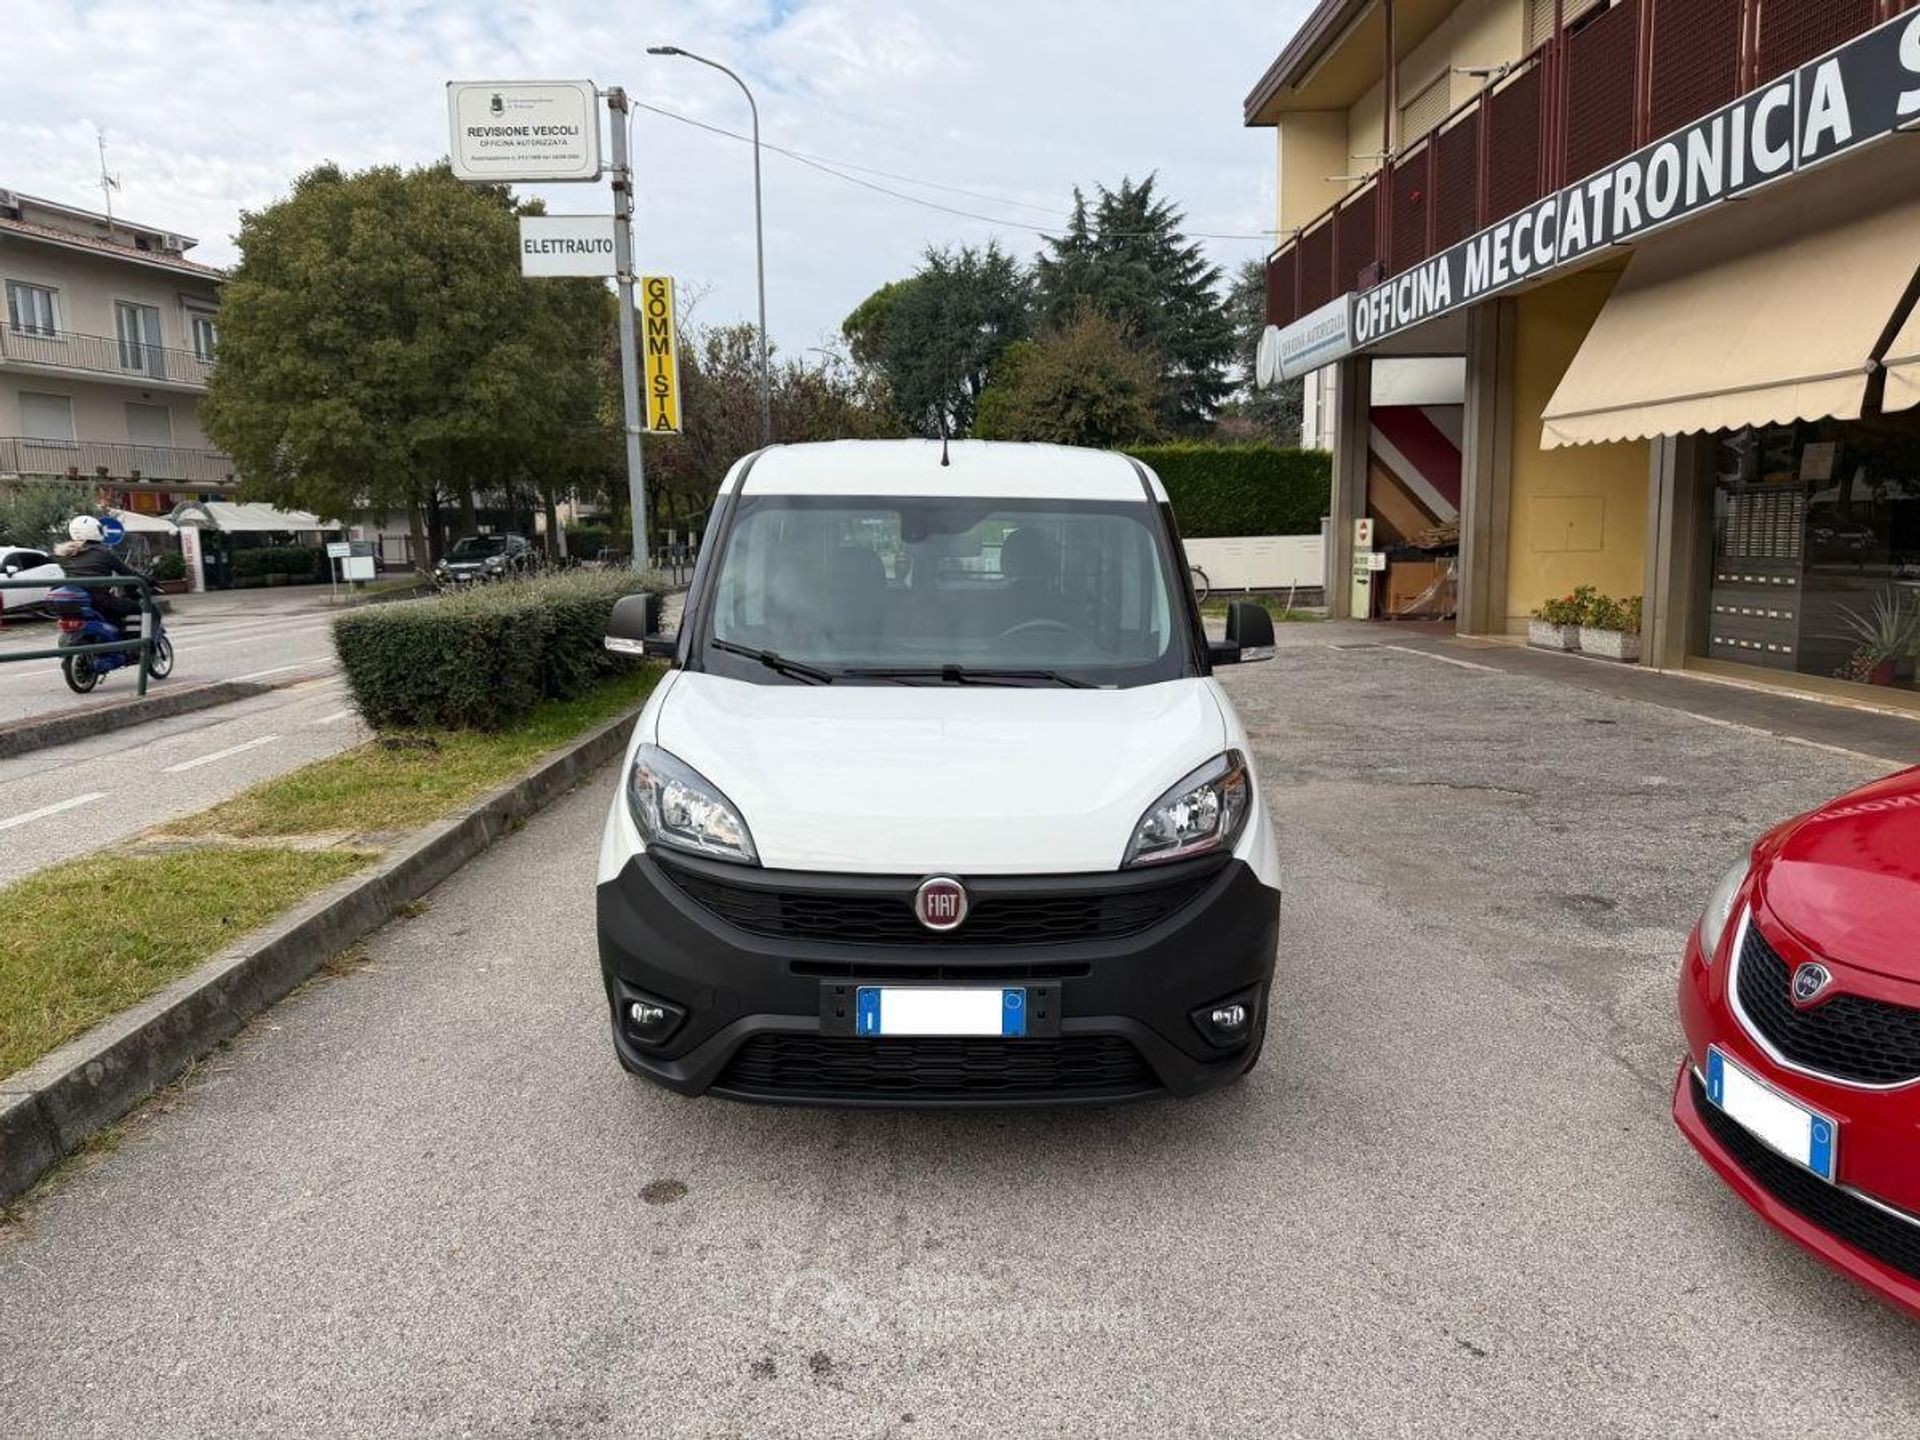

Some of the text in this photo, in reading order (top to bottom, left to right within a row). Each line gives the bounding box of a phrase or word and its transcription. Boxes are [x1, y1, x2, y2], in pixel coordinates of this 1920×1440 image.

[467, 125, 579, 137] REVISIONE VEICOLI
[480, 138, 568, 147] OFFICINA AUTORIZZATA
[1355, 255, 1451, 343] OFFICINA
[1463, 57, 1853, 298] MECCATRONICA
[524, 239, 613, 254] ELETTRAUTO
[648, 278, 672, 432] GOMMISTA
[927, 894, 957, 917] FIAT
